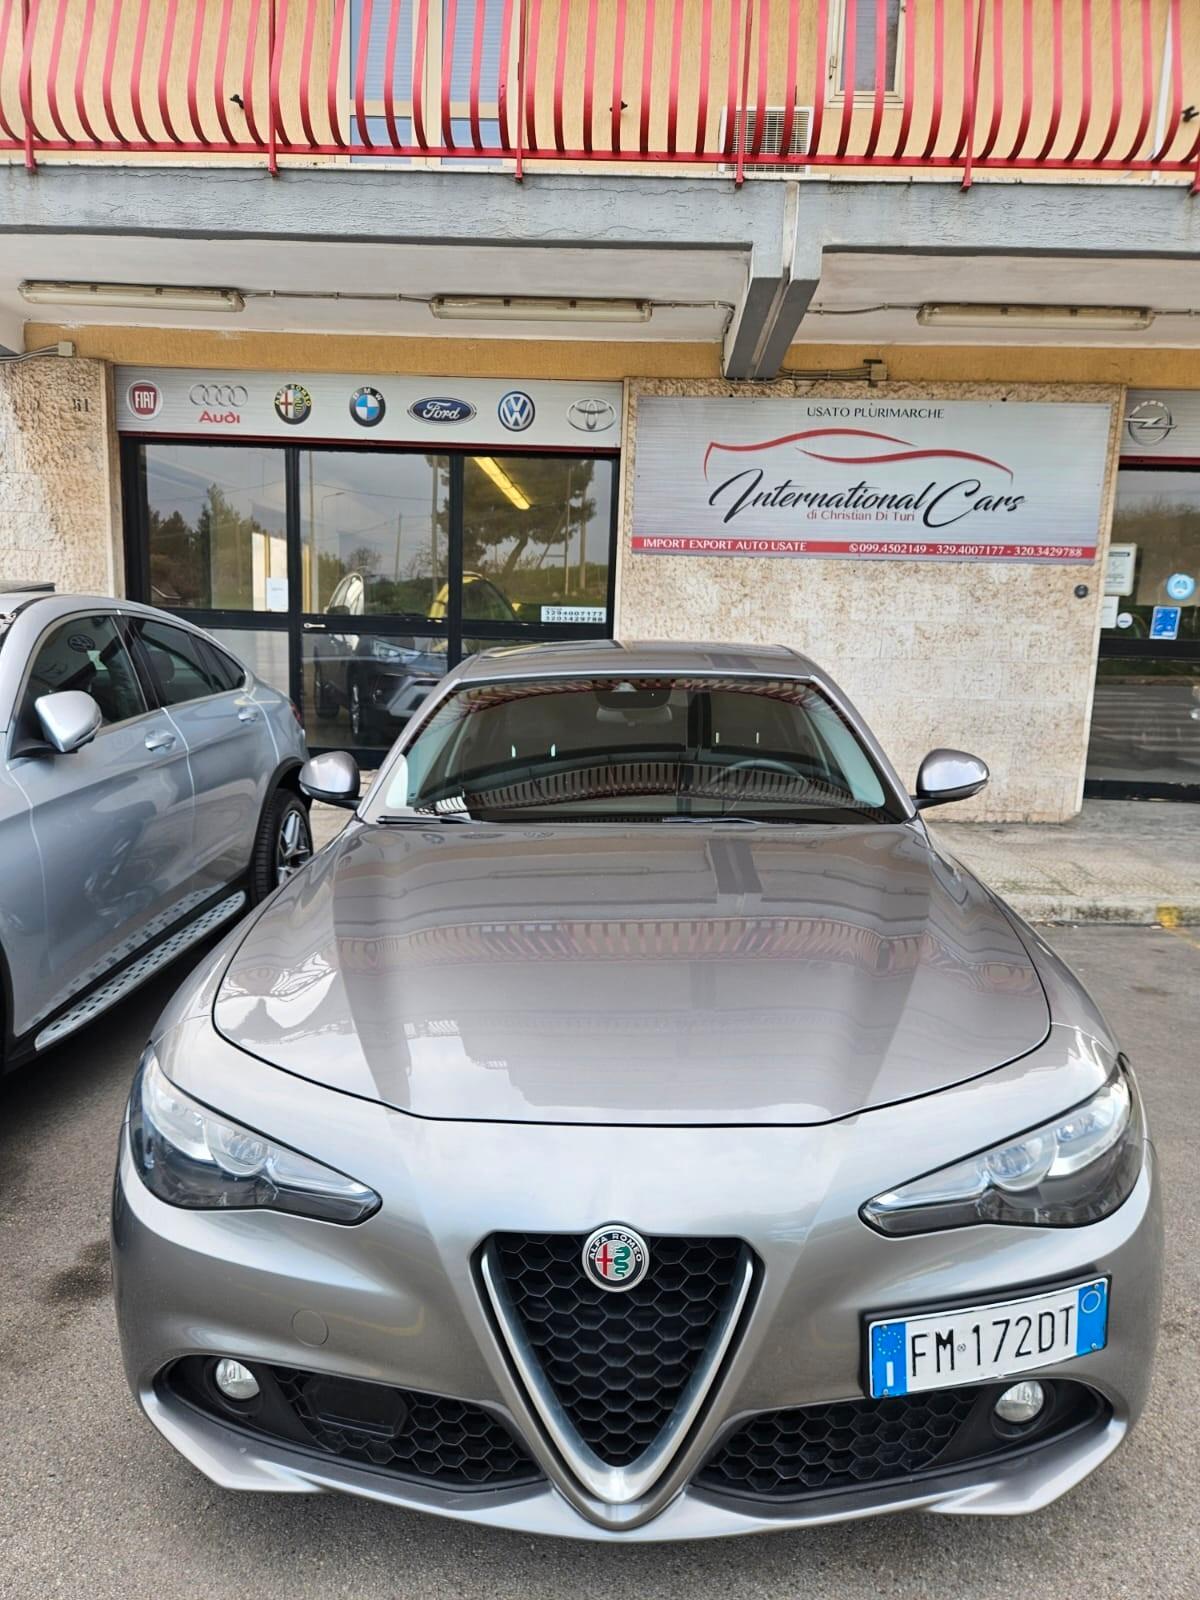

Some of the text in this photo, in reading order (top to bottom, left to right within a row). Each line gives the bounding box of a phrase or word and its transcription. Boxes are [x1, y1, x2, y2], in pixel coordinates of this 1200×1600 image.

[134, 391, 155, 409] FIAT
[352, 388, 383, 401] BMW
[198, 410, 240, 424] Audi
[422, 401, 461, 420] Ford
[807, 406, 945, 419] USATO PLURIMARCHE
[708, 468, 1025, 528] International Cars
[806, 511, 915, 521] di Christian Di Turi
[643, 538, 807, 552] IMPORT EXPORT AUTO USATE
[859, 543, 927, 554] 099.4502149
[936, 544, 1004, 556] 329.4007177
[1014, 546, 1083, 558] 320.3429788
[589, 1233, 642, 1262] ALFA ROMEO
